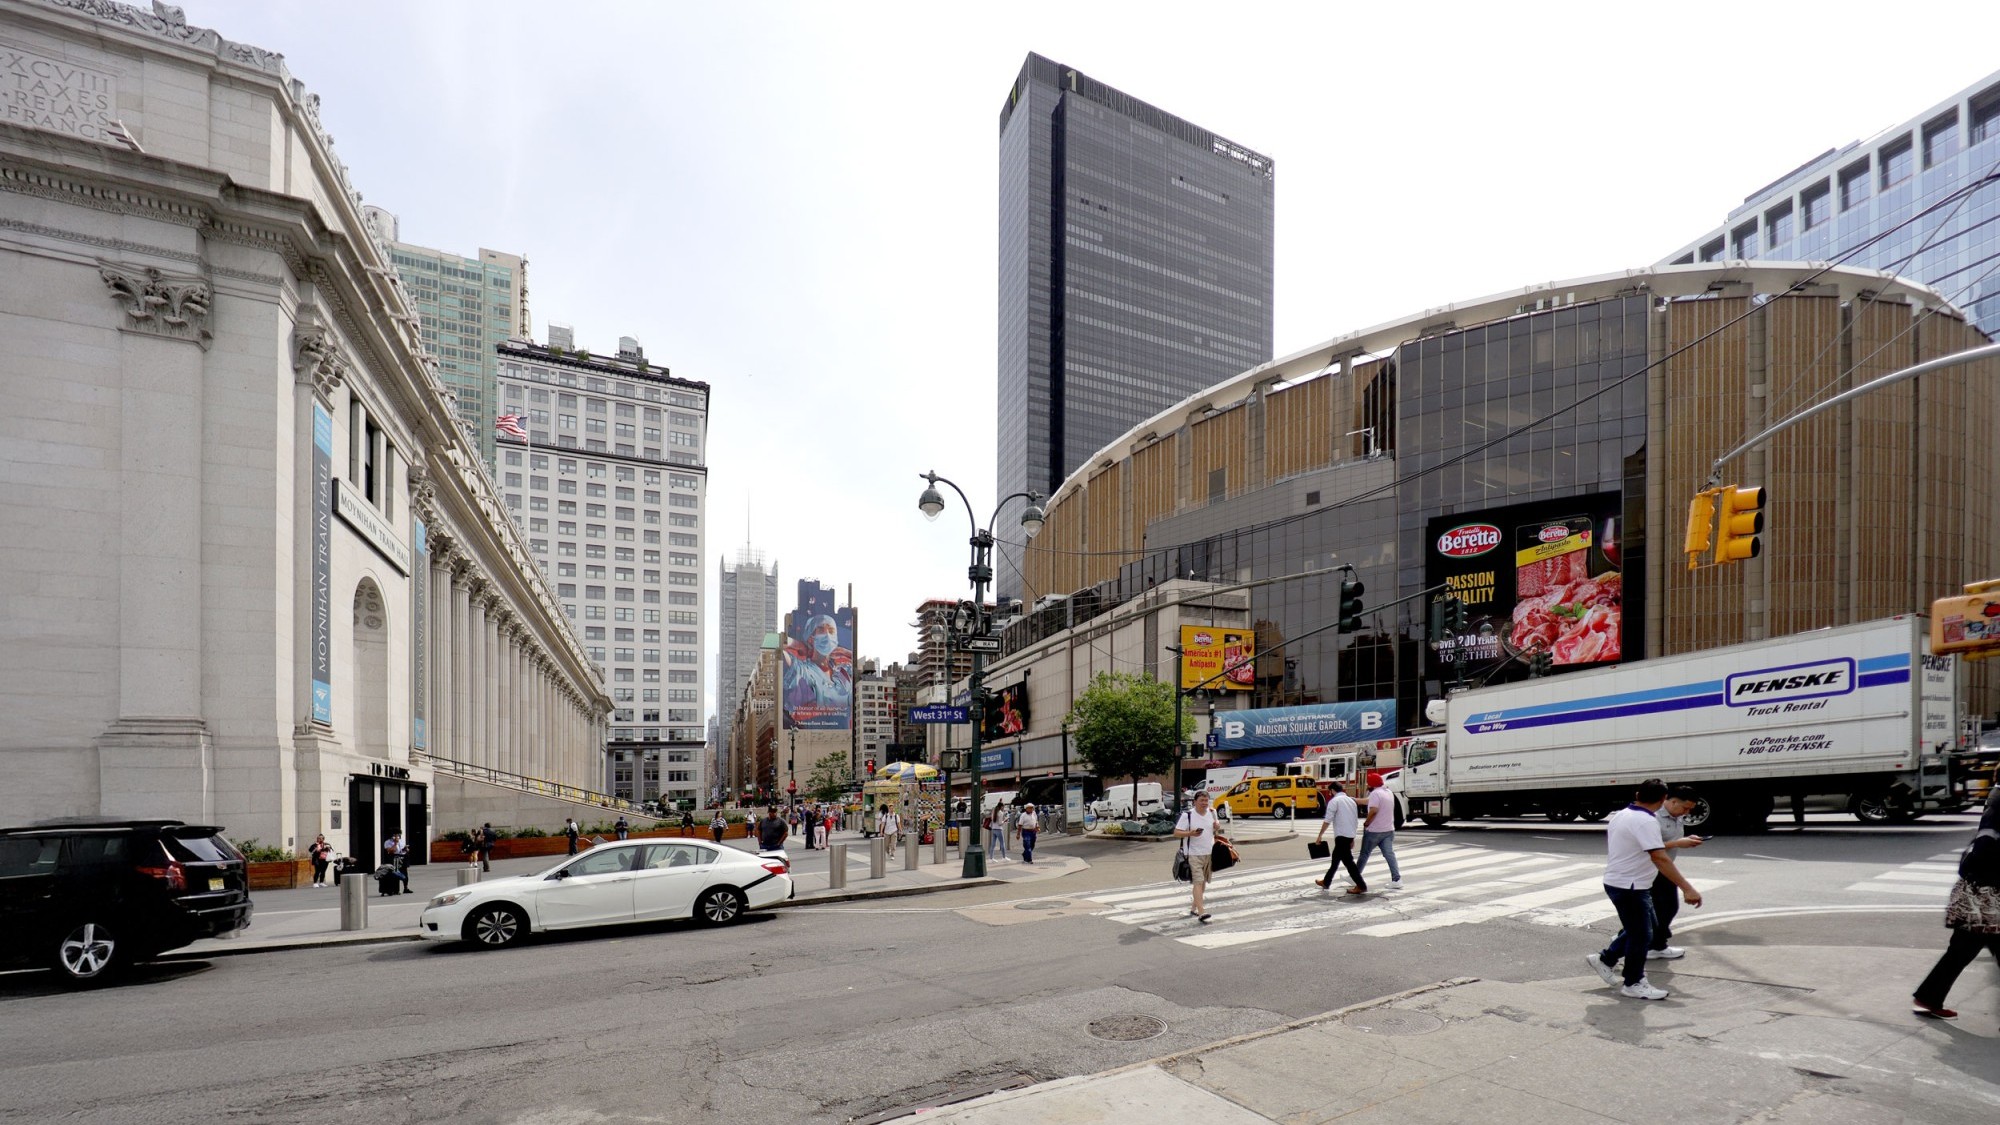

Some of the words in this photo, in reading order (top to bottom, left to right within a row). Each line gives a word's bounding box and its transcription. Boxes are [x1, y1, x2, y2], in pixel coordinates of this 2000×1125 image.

[1066, 69, 1077, 92] 1
[11, 71, 108, 110] TAXES
[15, 90, 109, 126] RELAYS
[319, 462, 328, 507] HALL
[319, 510, 328, 565] TRAIN
[340, 492, 377, 536] MOYNIHAN
[379, 529, 396, 552] TRAIN
[396, 548, 409, 567] HALL
[1539, 528, 1568, 540] Beretta
[1440, 530, 1499, 552] Beretta
[1445, 570, 1495, 589] PASSION
[318, 571, 328, 673] MOYNIHAN
[1193, 633, 1213, 644] Beretta
[1477, 635, 1499, 646] YEARS
[1184, 648, 1213, 658] America's
[1214, 650, 1222, 659] #1
[1920, 653, 1953, 672] PENSKE
[1190, 659, 1217, 669] Antipasto
[1735, 670, 1844, 696] PENSKE
[913, 710, 935, 720] West
[937, 710, 952, 720] 31st
[953, 710, 963, 720] St
[1297, 713, 1336, 721] ENTRANCE
[1484, 712, 1503, 721] Local
[1747, 704, 1781, 717] Truck
[1783, 699, 1828, 713] Rental
[1255, 724, 1288, 736] MADISON
[1289, 721, 1317, 733] SQUARE
[1319, 719, 1348, 731] GARDEN
[1361, 711, 1383, 730] B
[1479, 724, 1491, 732] One
[1492, 722, 1507, 731] Way
[1225, 721, 1245, 739] B
[1738, 740, 1834, 755] 1-800-GO-PENSKE
[1749, 734, 1825, 746] GoPenske.com
